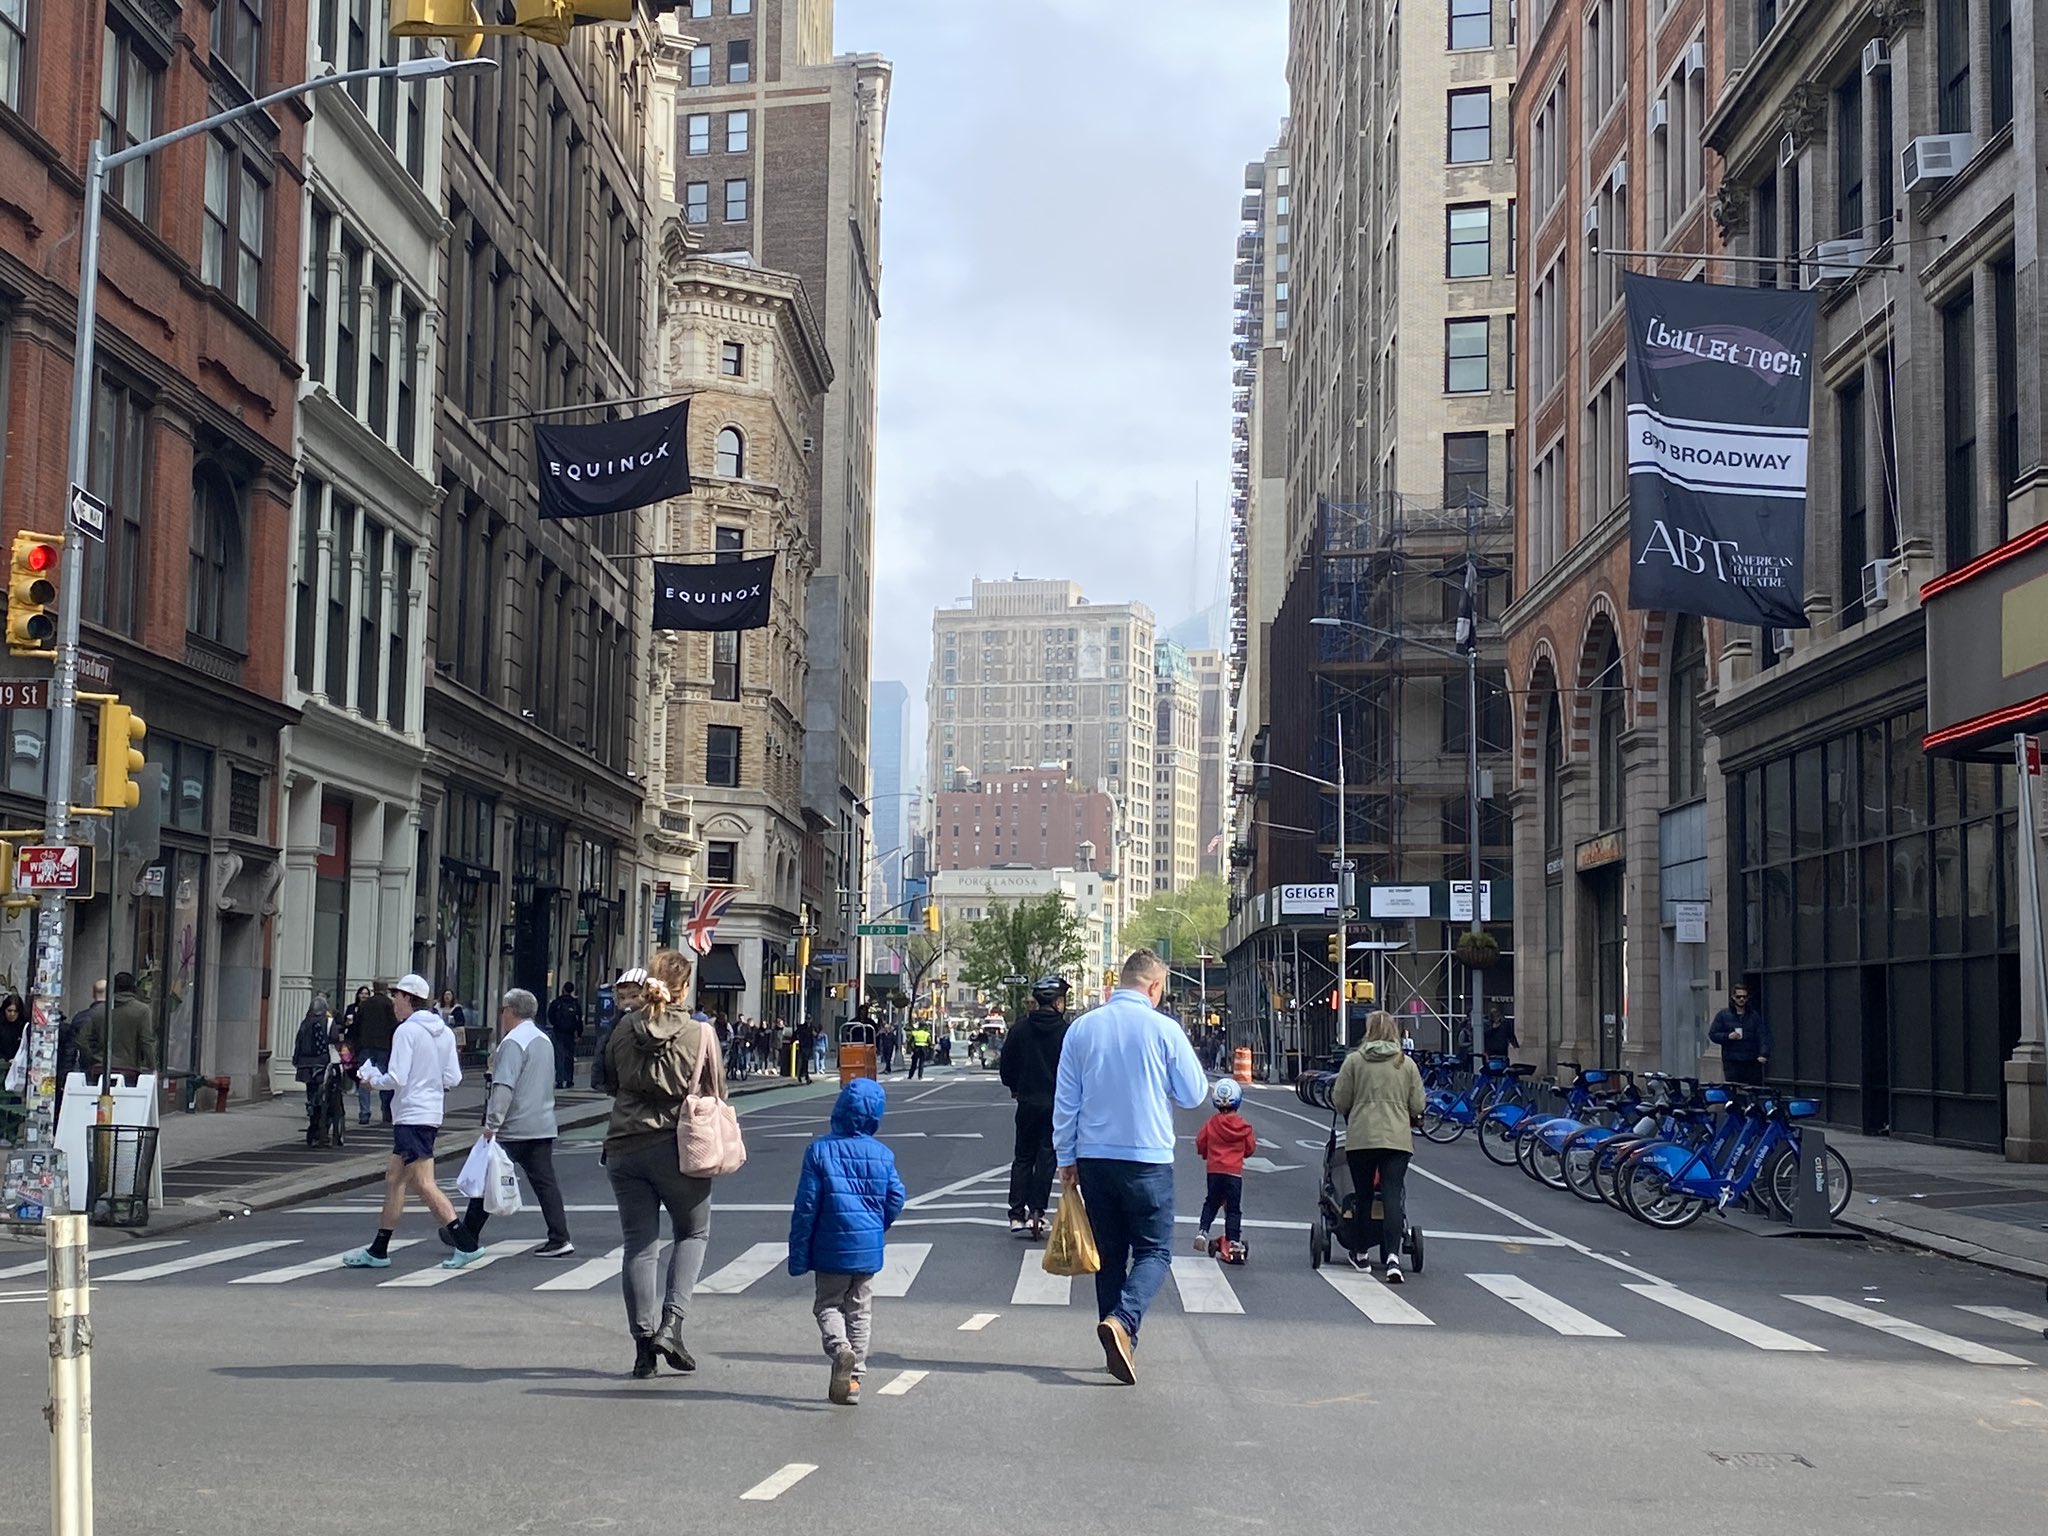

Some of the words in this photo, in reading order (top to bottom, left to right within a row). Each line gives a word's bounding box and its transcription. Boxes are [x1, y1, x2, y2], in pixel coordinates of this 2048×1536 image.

[549, 441, 670, 482] EQUINOX
[1669, 444, 1792, 470] BROADWAY
[1636, 519, 1739, 583] ABT
[1731, 554, 1794, 567] AMERICAN
[1732, 565, 1781, 578] BALLET
[1731, 576, 1786, 588] THEATRE
[665, 583, 761, 604] EQUINOX
[77, 657, 110, 686] roadway
[21, 685, 38, 705] St
[36, 873, 59, 884] WAY
[958, 877, 1038, 887] PORCELANOSA
[1284, 887, 1335, 899] GEIGER
